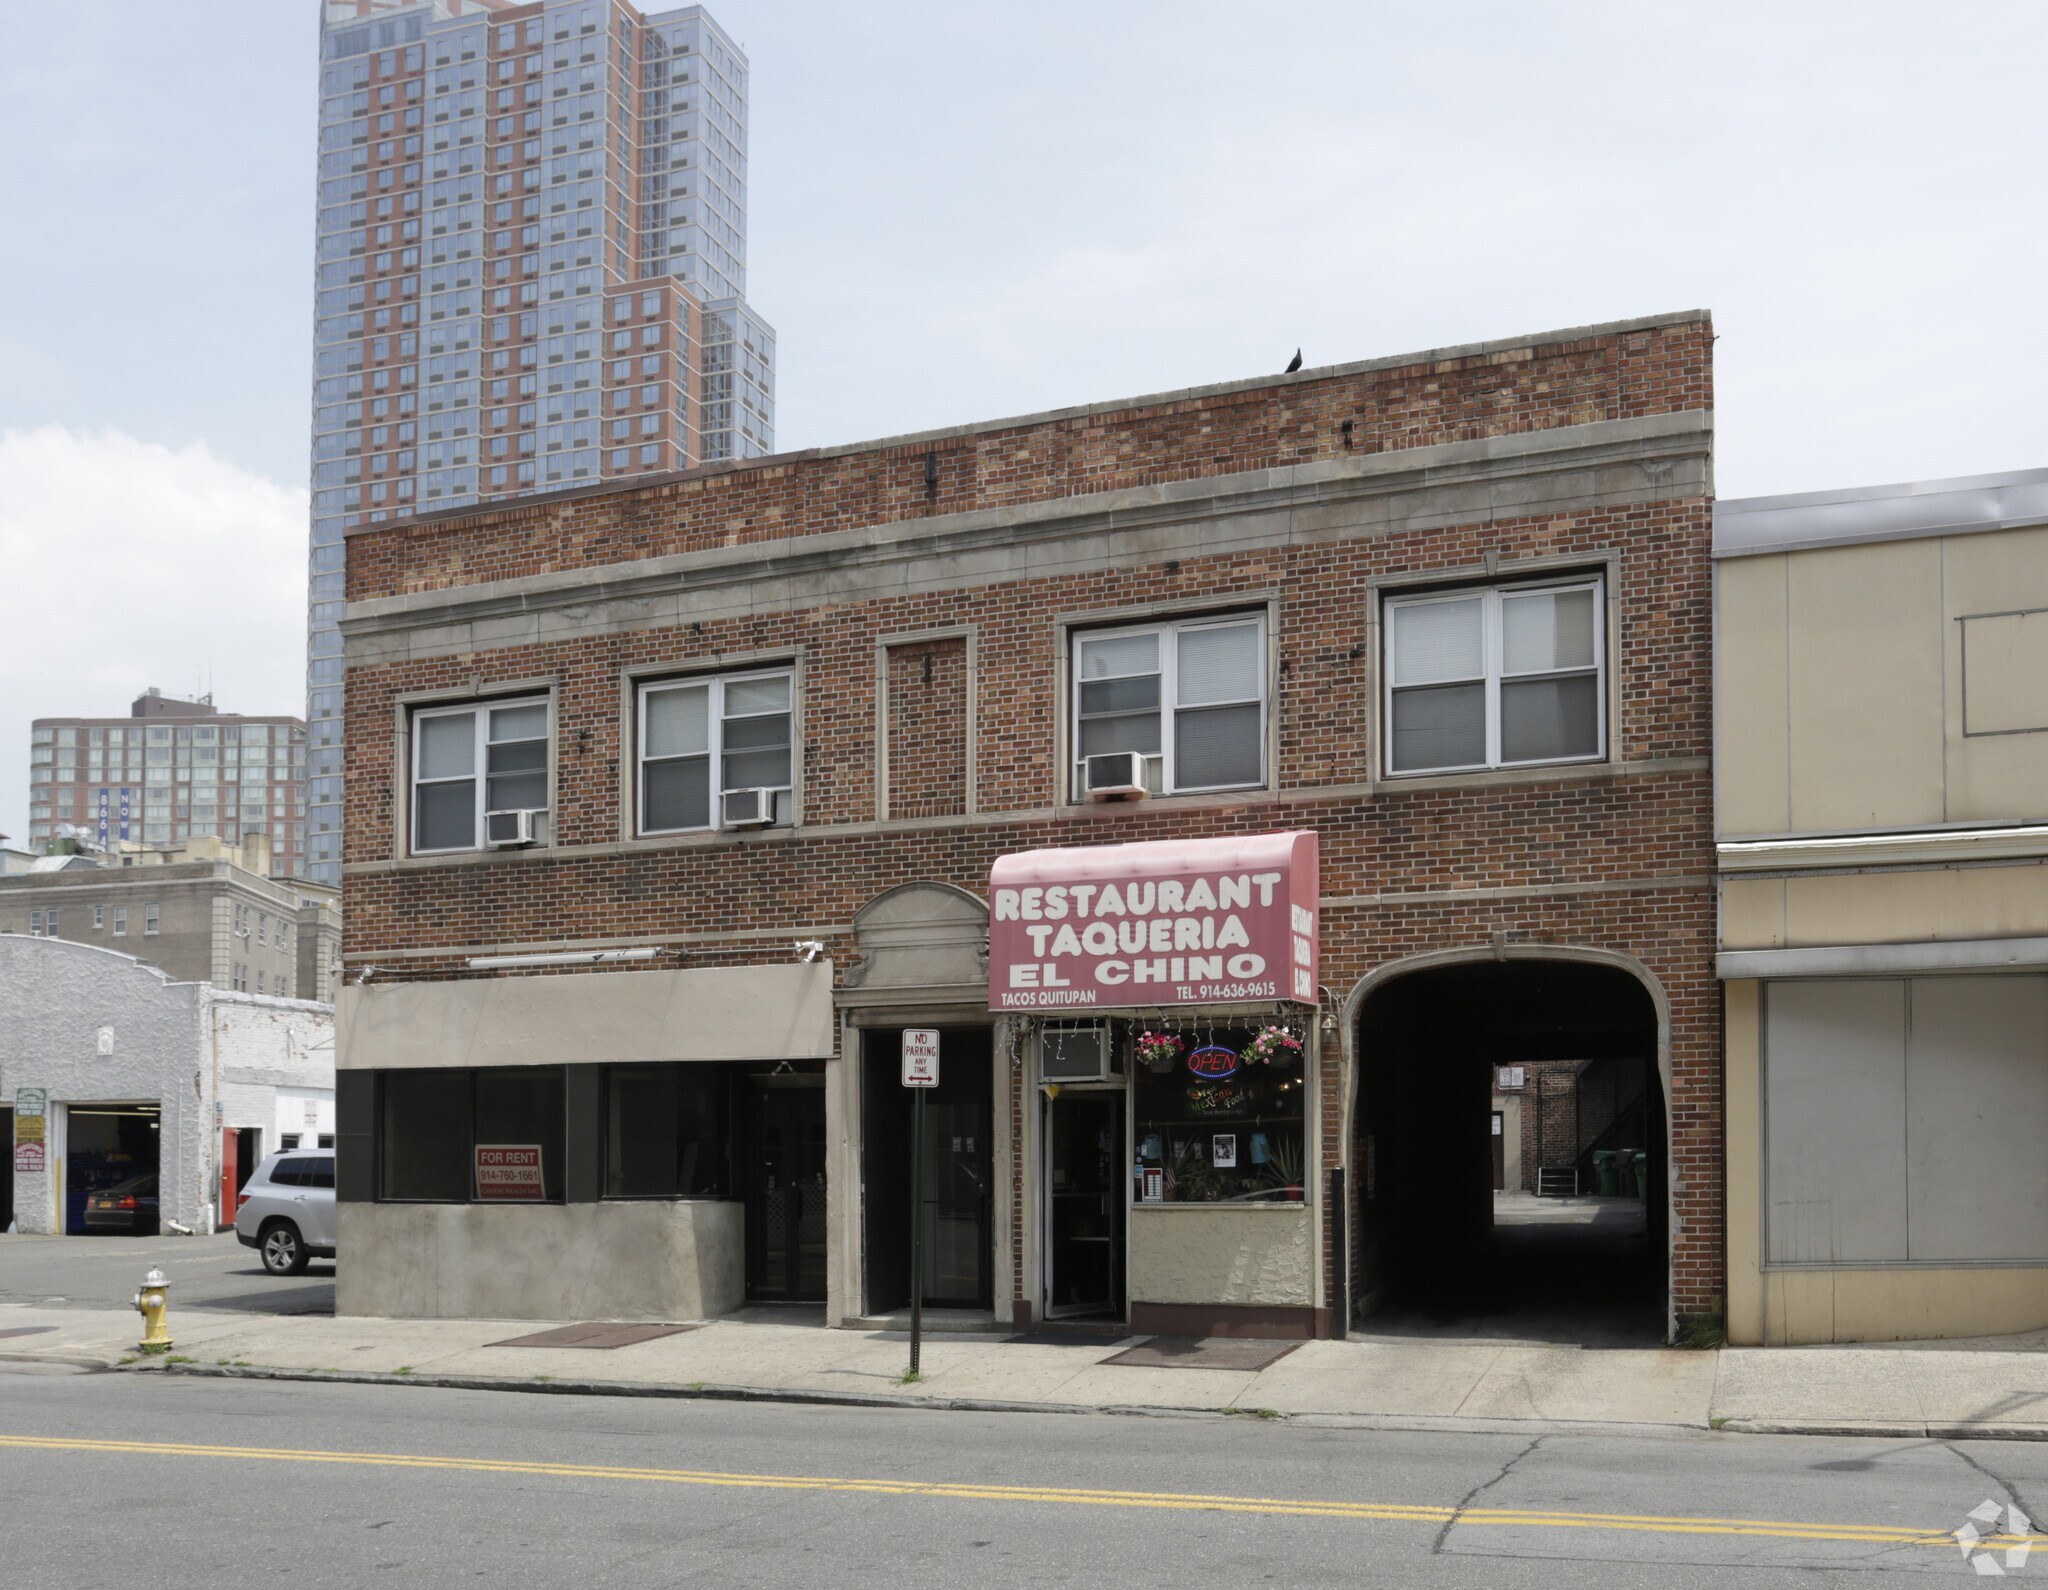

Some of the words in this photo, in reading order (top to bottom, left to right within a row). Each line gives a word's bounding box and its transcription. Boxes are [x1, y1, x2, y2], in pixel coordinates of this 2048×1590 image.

[995, 872, 1282, 922] RESTAURANT
[1026, 914, 1250, 958] TAQUERIA
[1009, 963, 1070, 988] EL
[1094, 953, 1266, 985] CHINO
[1001, 992, 1036, 1006] TACOS
[1039, 989, 1096, 1005] QUITUPAN
[1176, 985, 1198, 1000] TEL.
[1200, 981, 1276, 999] 914-636-9615
[915, 1033, 928, 1044] NO
[906, 1045, 936, 1057] PARKING
[914, 1066, 928, 1074] TIME
[1188, 1054, 1238, 1071] OPEN
[1190, 1088, 1233, 1112] Mexican
[1224, 1087, 1245, 1109] Food
[481, 1152, 503, 1163] FOR
[506, 1152, 535, 1163] RENT
[481, 1170, 537, 1180] 914-760-1661
